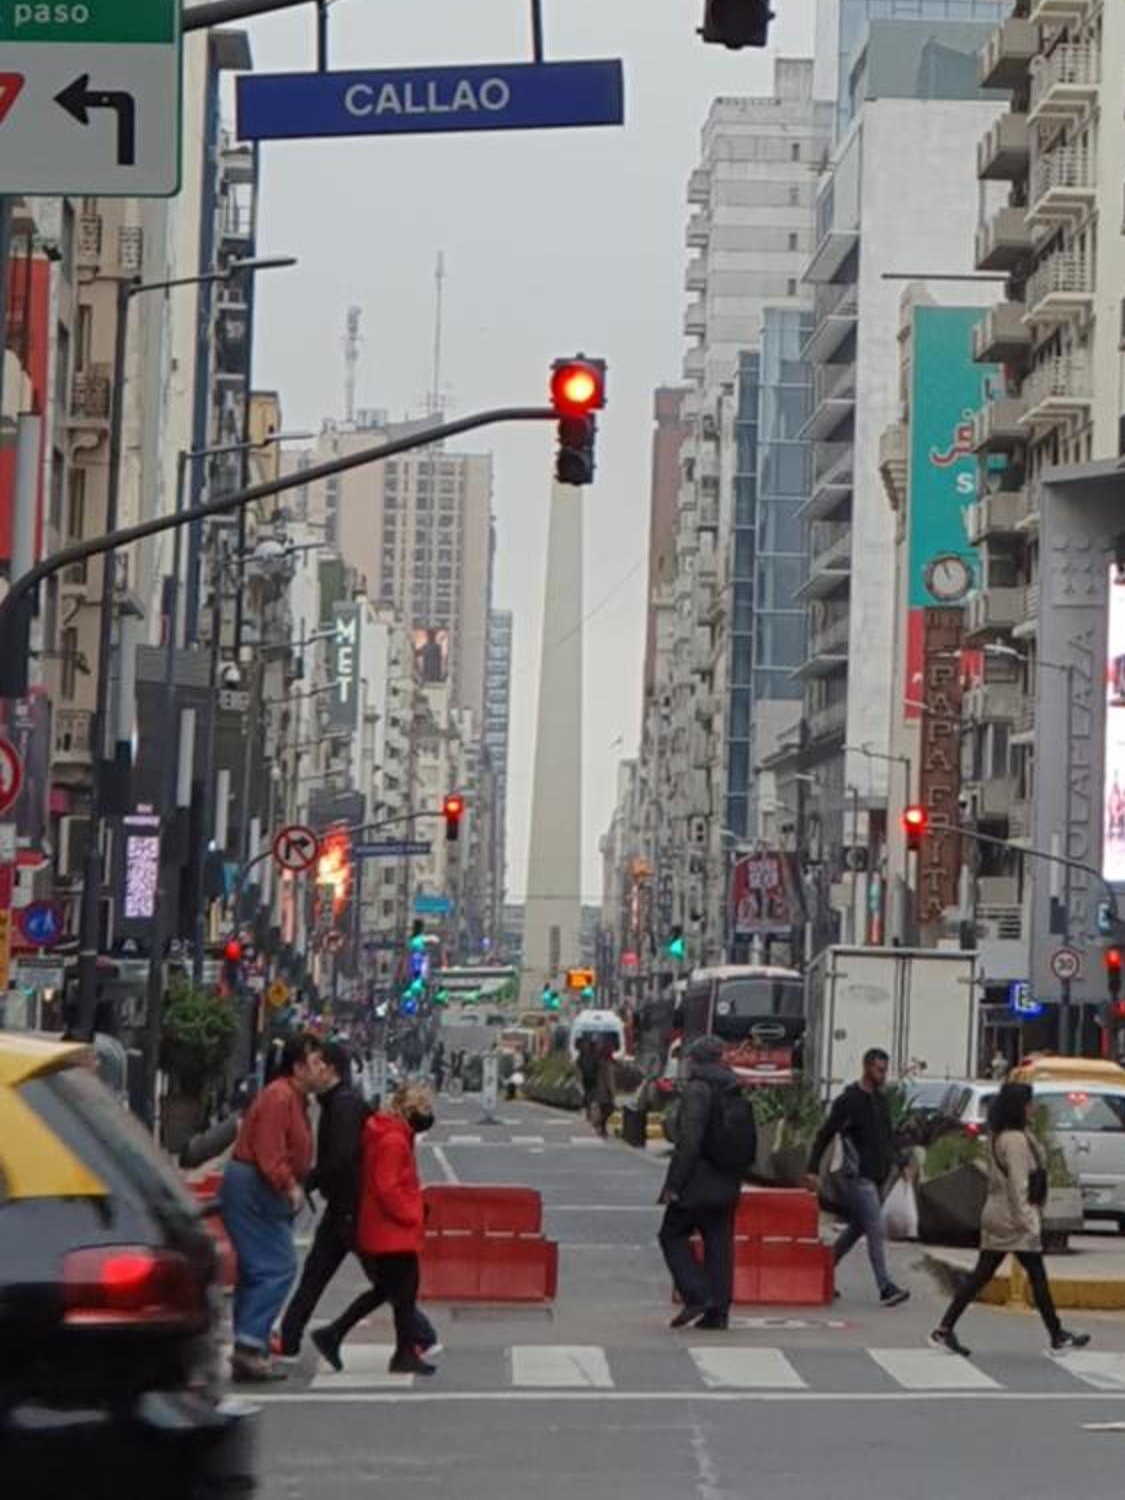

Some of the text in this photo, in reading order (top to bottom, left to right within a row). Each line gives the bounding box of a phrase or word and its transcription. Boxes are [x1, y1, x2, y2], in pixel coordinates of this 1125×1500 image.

[14, 2, 91, 27] paso
[344, 77, 511, 117] CALLAO
[334, 617, 356, 702] MET
